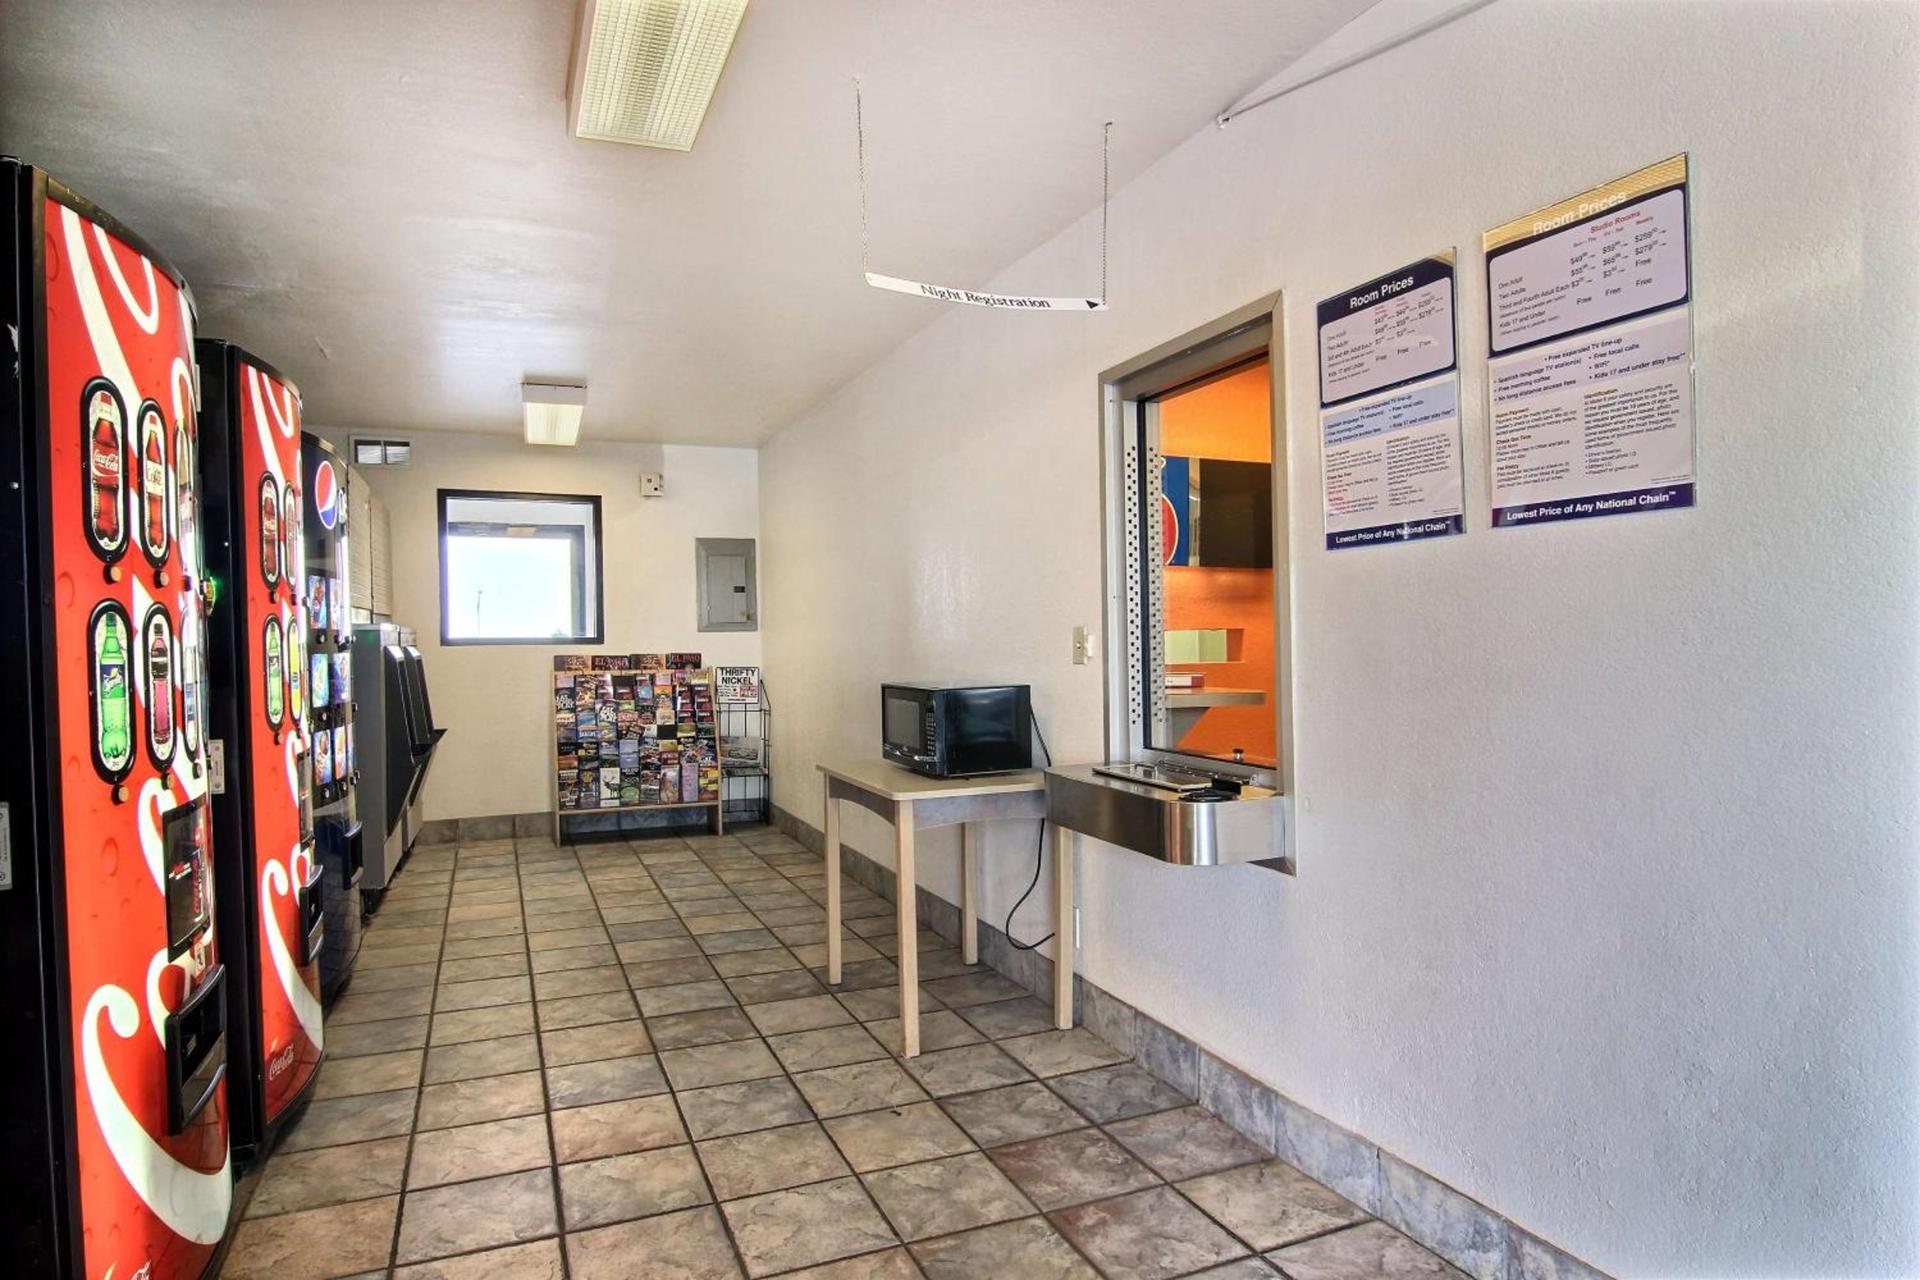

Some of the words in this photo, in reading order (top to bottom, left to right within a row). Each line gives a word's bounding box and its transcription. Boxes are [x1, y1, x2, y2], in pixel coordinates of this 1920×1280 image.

[1532, 212, 1573, 235] Room
[1578, 192, 1625, 218] Prices
[1614, 211, 1639, 224] Rooms
[920, 284, 962, 300] Night
[964, 291, 1051, 308] Registration
[1349, 291, 1378, 309] Room
[1381, 276, 1413, 297] Prices
[1576, 296, 1591, 305] Free
[1635, 277, 1652, 287] Free
[1562, 345, 1590, 356] expanded
[1600, 338, 1622, 346] line-up
[1608, 346, 1622, 355] local
[1624, 343, 1639, 351] calls
[1497, 373, 1518, 382] Spanish
[1594, 371, 1607, 379] Kids
[1618, 364, 1630, 373] and
[1631, 362, 1649, 370] under
[94, 448, 118, 472] Coca-Cola
[1506, 508, 1537, 521] Lowest
[1539, 506, 1562, 517] Price
[1563, 503, 1573, 513] of
[1574, 502, 1592, 512] Any
[1595, 495, 1636, 510] National
[1335, 533, 1357, 544] Lowest
[1358, 531, 1373, 540] Price
[1374, 529, 1381, 538] of
[720, 668, 756, 676] THRIFTY
[722, 676, 753, 685] NICKEL
[269, 1043, 294, 1080] Coca-Cola
